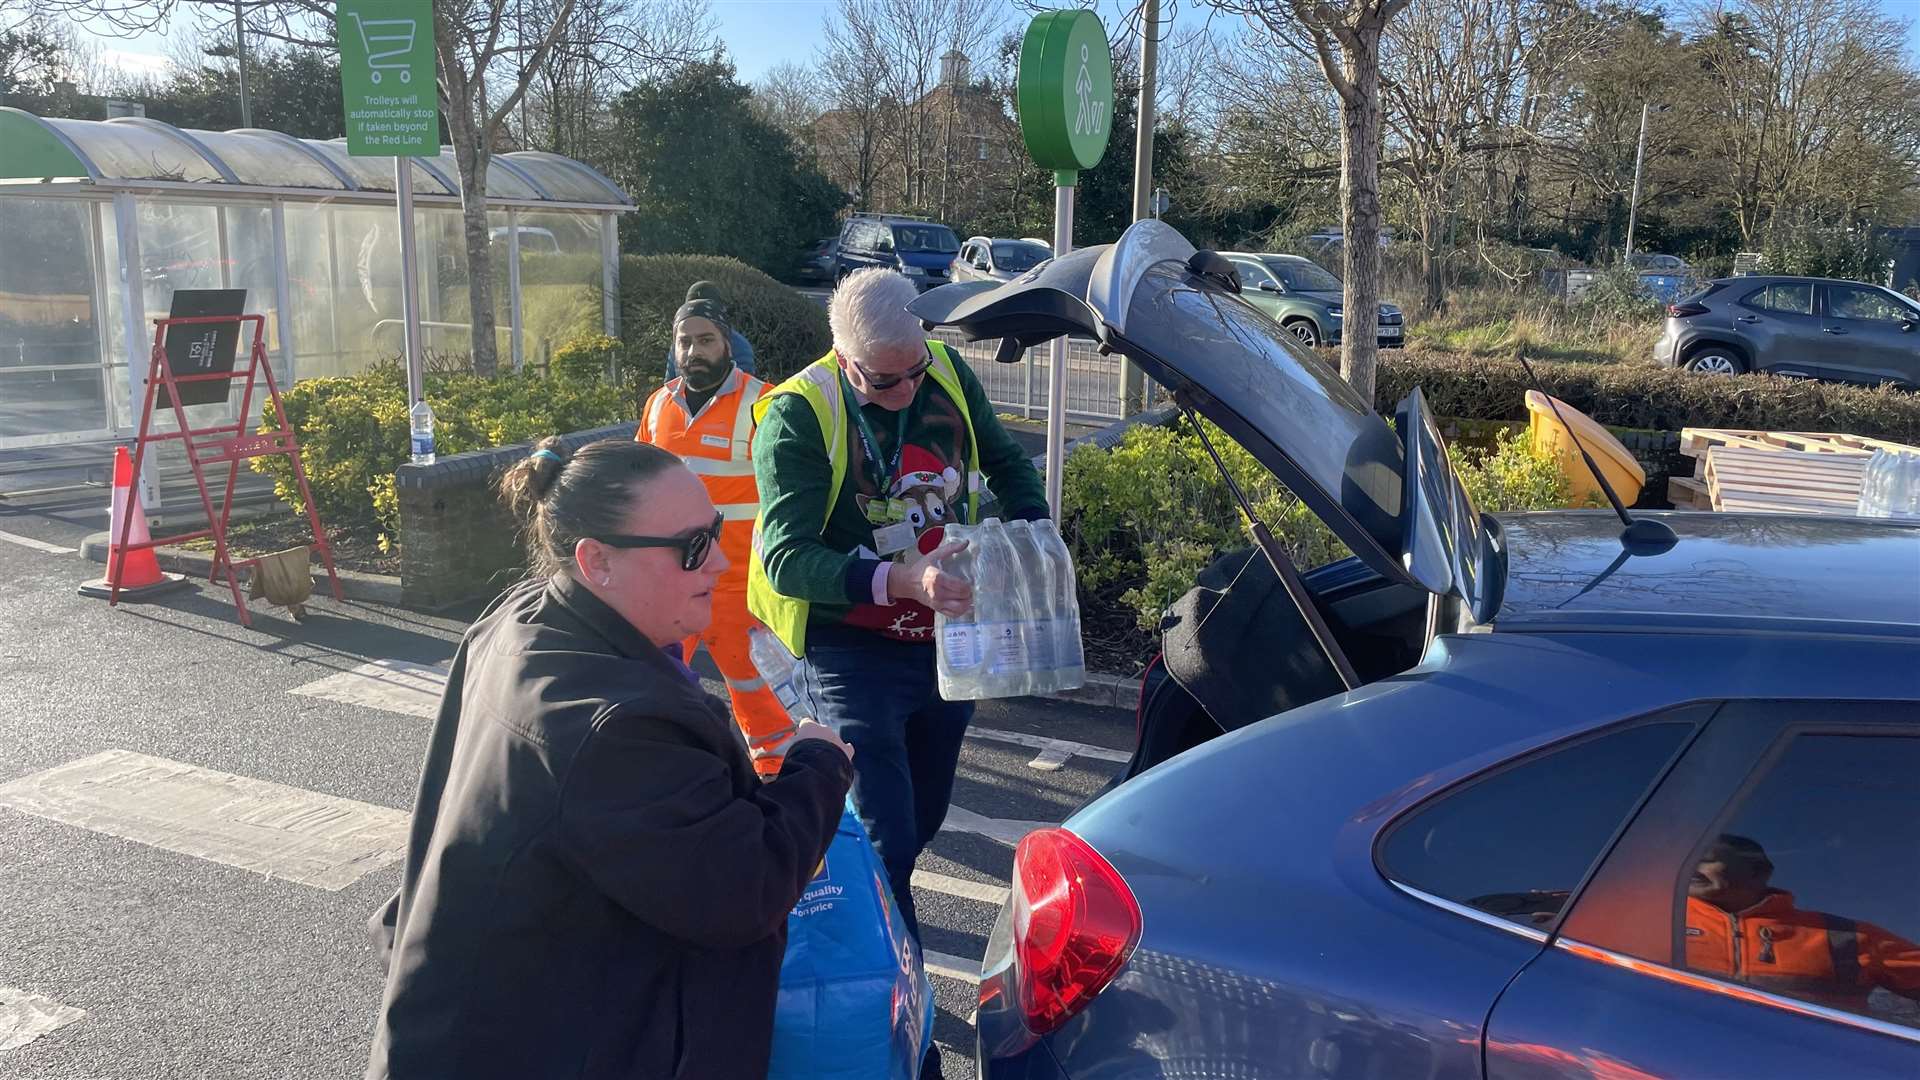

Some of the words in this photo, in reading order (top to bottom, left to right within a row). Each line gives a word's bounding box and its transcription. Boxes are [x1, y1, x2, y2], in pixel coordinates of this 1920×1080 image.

[364, 95, 400, 106] Trolleys
[401, 95, 418, 105] will
[350, 108, 411, 119] automatically
[413, 109, 434, 119] stop
[358, 121, 364, 132] if
[366, 121, 392, 132] taken
[393, 121, 428, 133] beyond
[365, 135, 380, 145] the
[382, 135, 401, 145] Red
[402, 135, 423, 145] Line
[803, 884, 844, 901] quality
[798, 907, 809, 918] on
[809, 902, 833, 916] price
